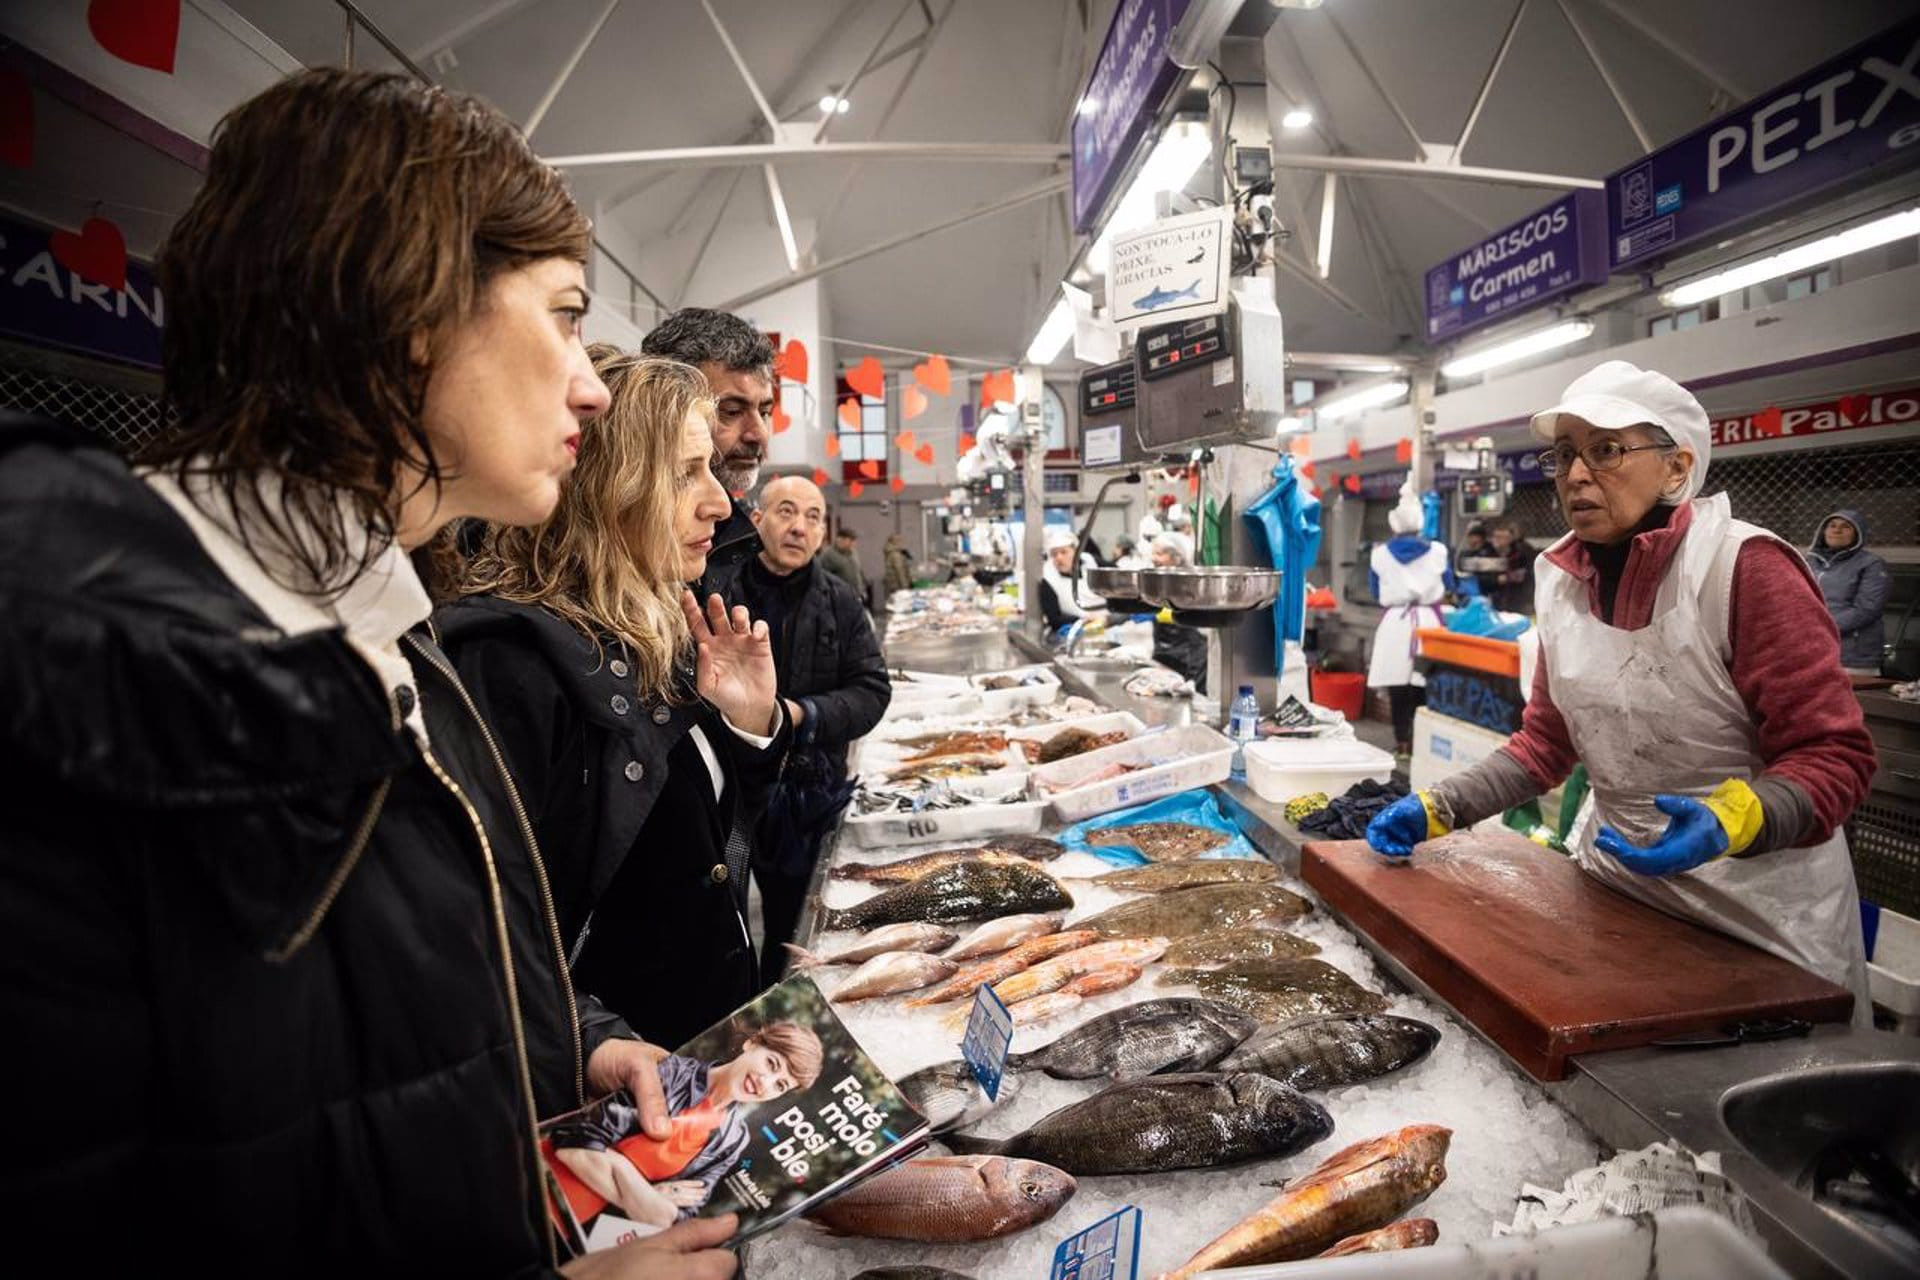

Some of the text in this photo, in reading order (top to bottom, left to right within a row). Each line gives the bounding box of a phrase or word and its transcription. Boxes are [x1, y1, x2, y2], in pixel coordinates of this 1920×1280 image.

[1117, 243, 1141, 257] NON
[1117, 254, 1153, 273] PEIXE
[1457, 206, 1568, 280] MARISCOS
[0, 234, 164, 328] ARN
[1116, 265, 1173, 286] GRACIAS
[1469, 250, 1556, 301] Carmen
[831, 1075, 889, 1130] Faré
[773, 1105, 837, 1156] posi
[818, 1102, 877, 1156] molo
